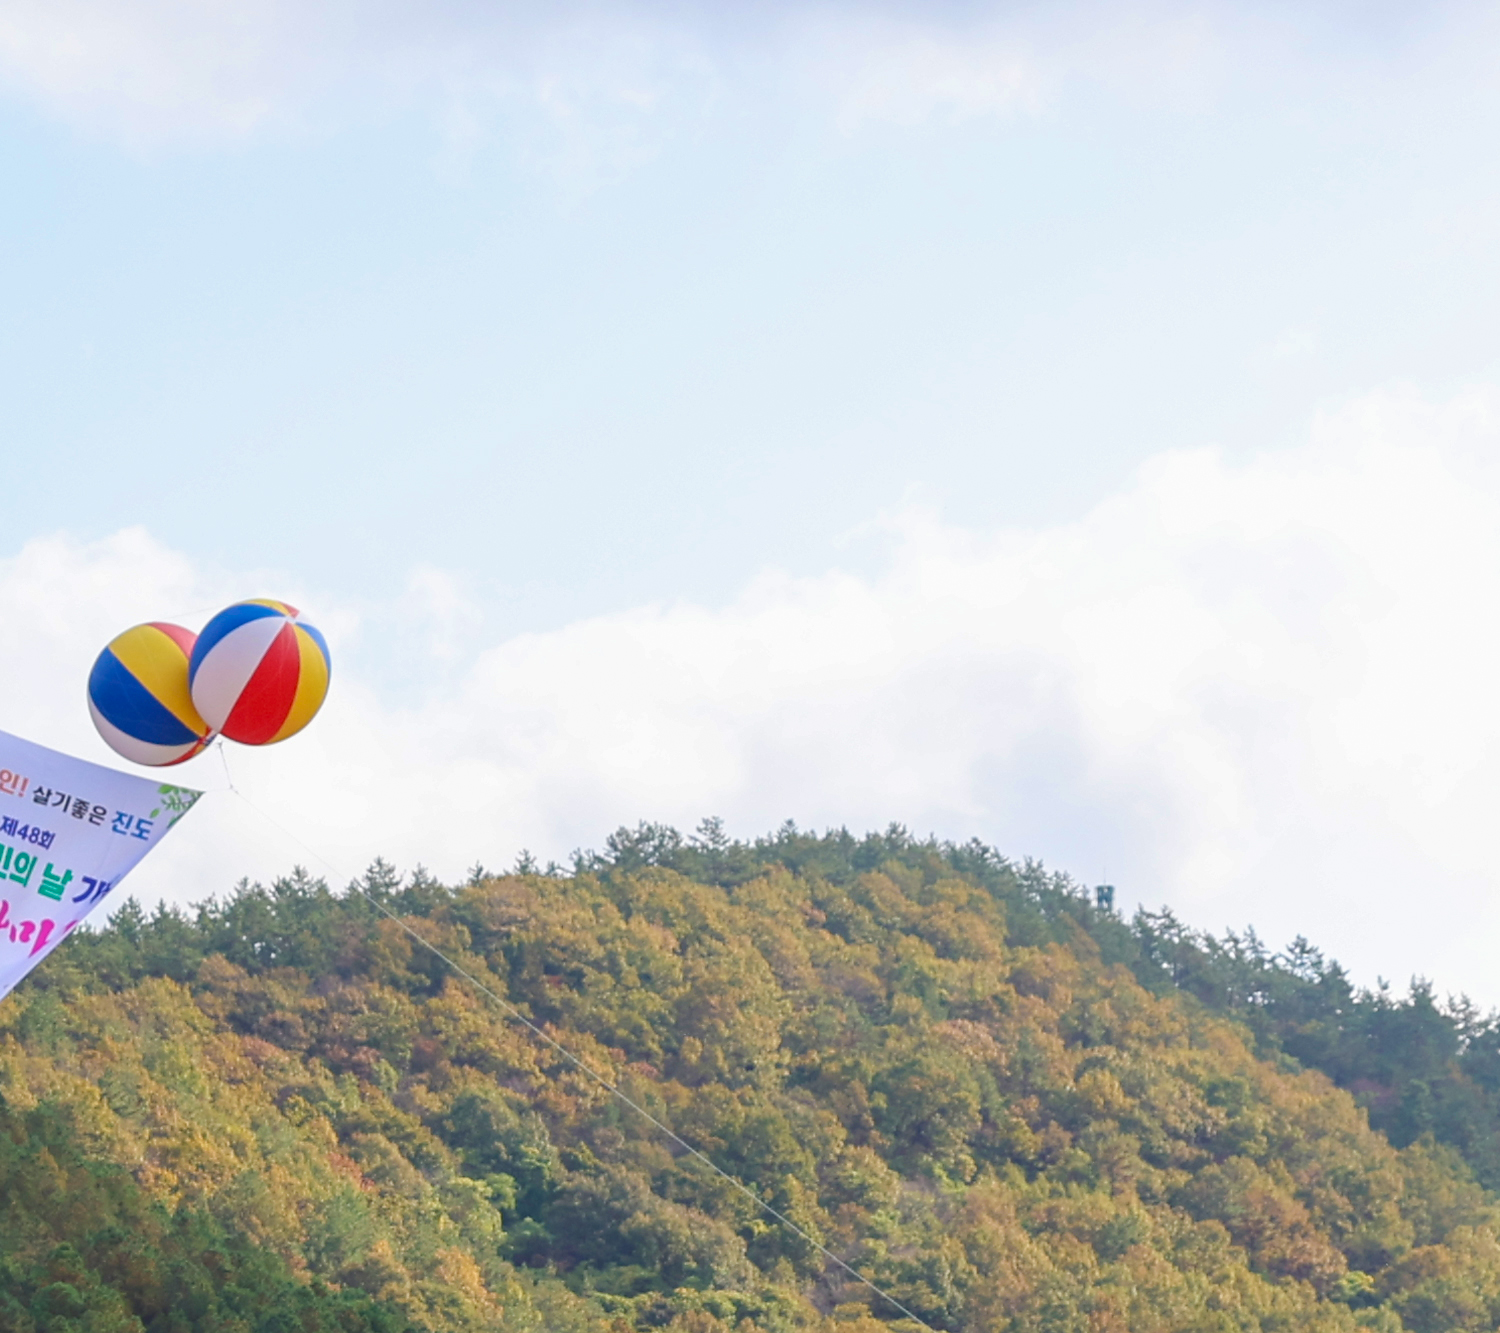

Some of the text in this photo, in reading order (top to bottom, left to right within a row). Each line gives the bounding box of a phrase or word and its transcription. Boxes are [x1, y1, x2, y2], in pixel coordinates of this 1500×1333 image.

[33, 785, 108, 826] 살기좋은
[111, 810, 154, 841] 진도
[0, 815, 56, 850] 제48회
[37, 863, 73, 901] 날
